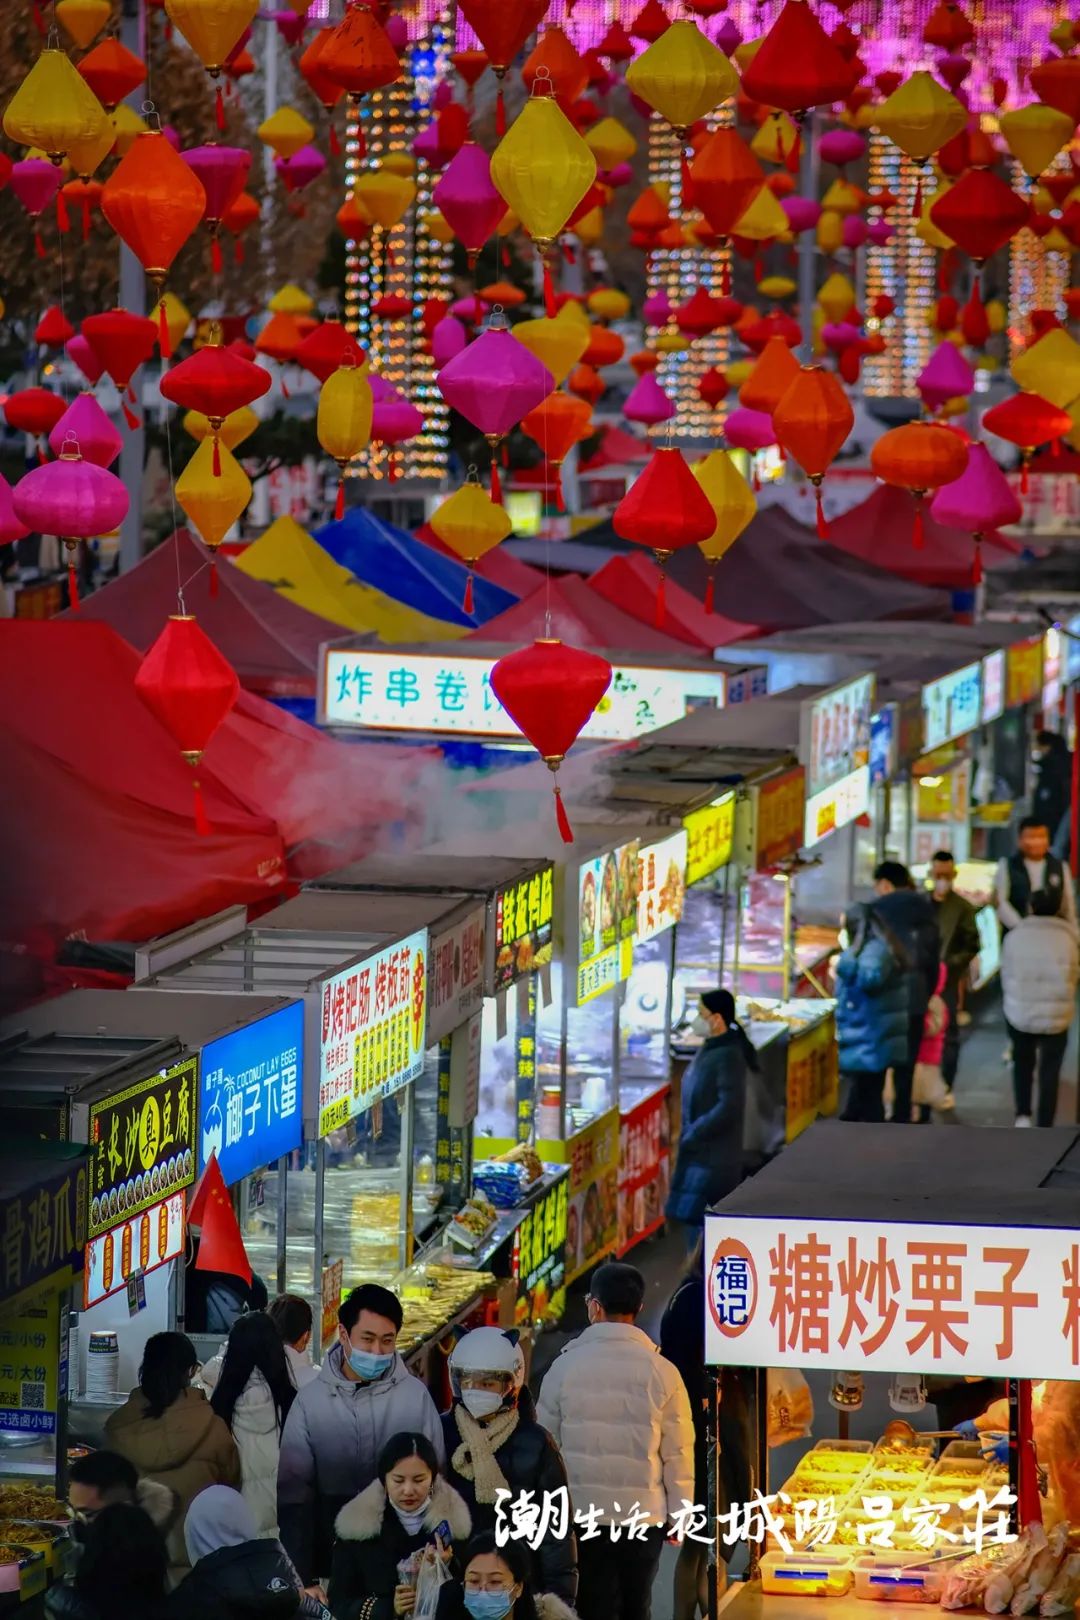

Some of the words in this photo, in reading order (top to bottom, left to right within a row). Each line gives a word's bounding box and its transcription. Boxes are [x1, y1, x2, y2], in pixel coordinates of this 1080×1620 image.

[226, 1064, 297, 1148] 椰子下蛋
[237, 1062, 265, 1090] COCONUT
[266, 1056, 279, 1075] LAY
[107, 1076, 190, 1182] 长沙臭豆腐
[716, 1256, 749, 1326] 福记
[769, 1232, 1039, 1361] 糖炒栗子
